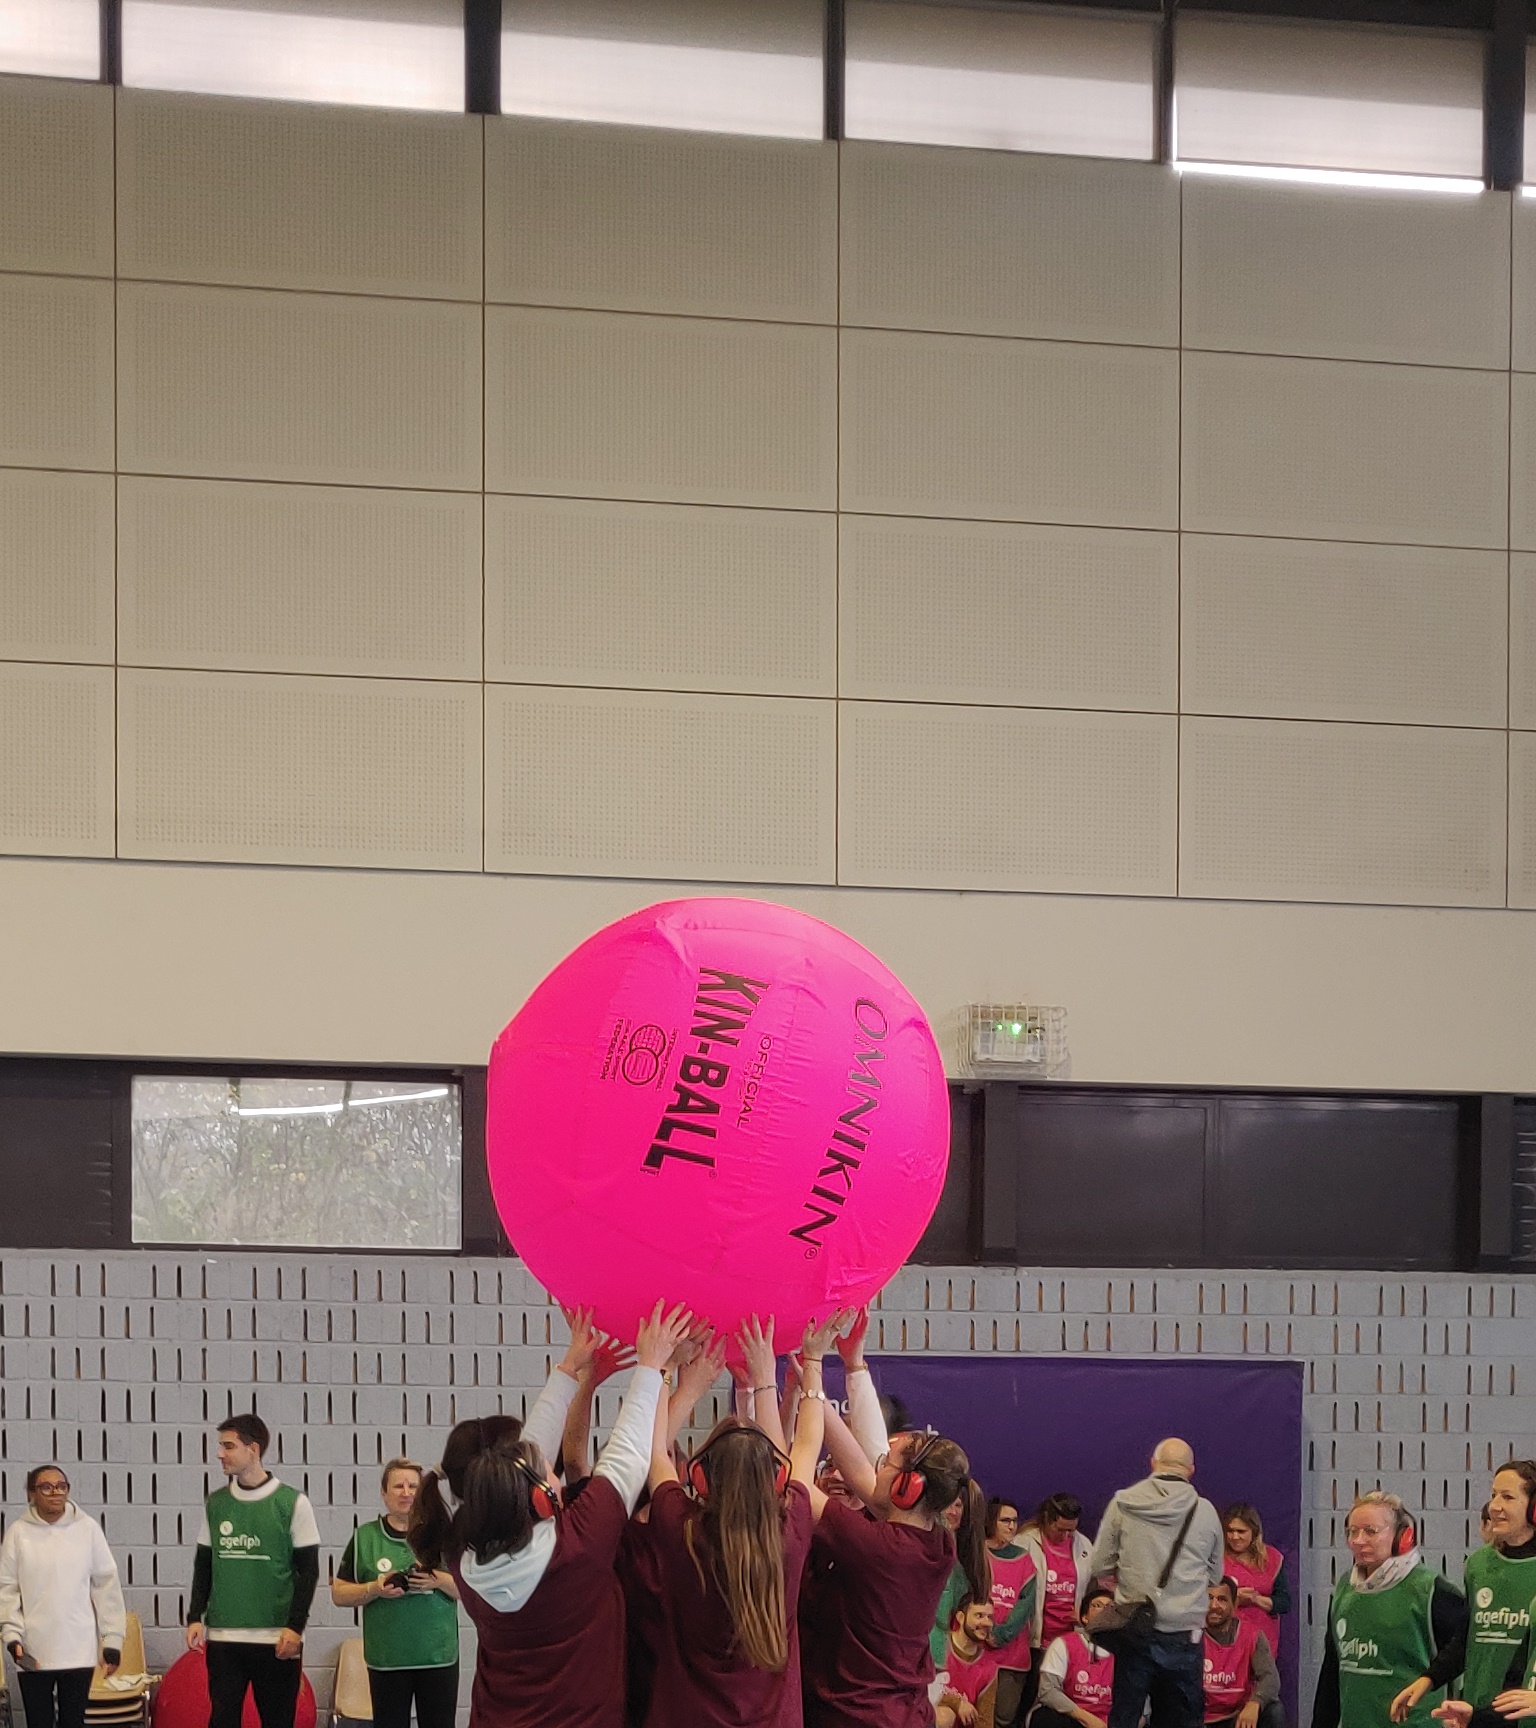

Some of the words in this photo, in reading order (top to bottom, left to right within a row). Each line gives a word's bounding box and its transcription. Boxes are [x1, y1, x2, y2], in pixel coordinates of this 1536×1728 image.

[642, 966, 772, 1173] KIN-BALL
[737, 1036, 772, 1128] OFFICIAL
[788, 998, 888, 1248] OMNIKIN
[1046, 1581, 1075, 1594] agefip
[1475, 1607, 1530, 1629] agefiph
[1203, 1671, 1236, 1685] gefiph
